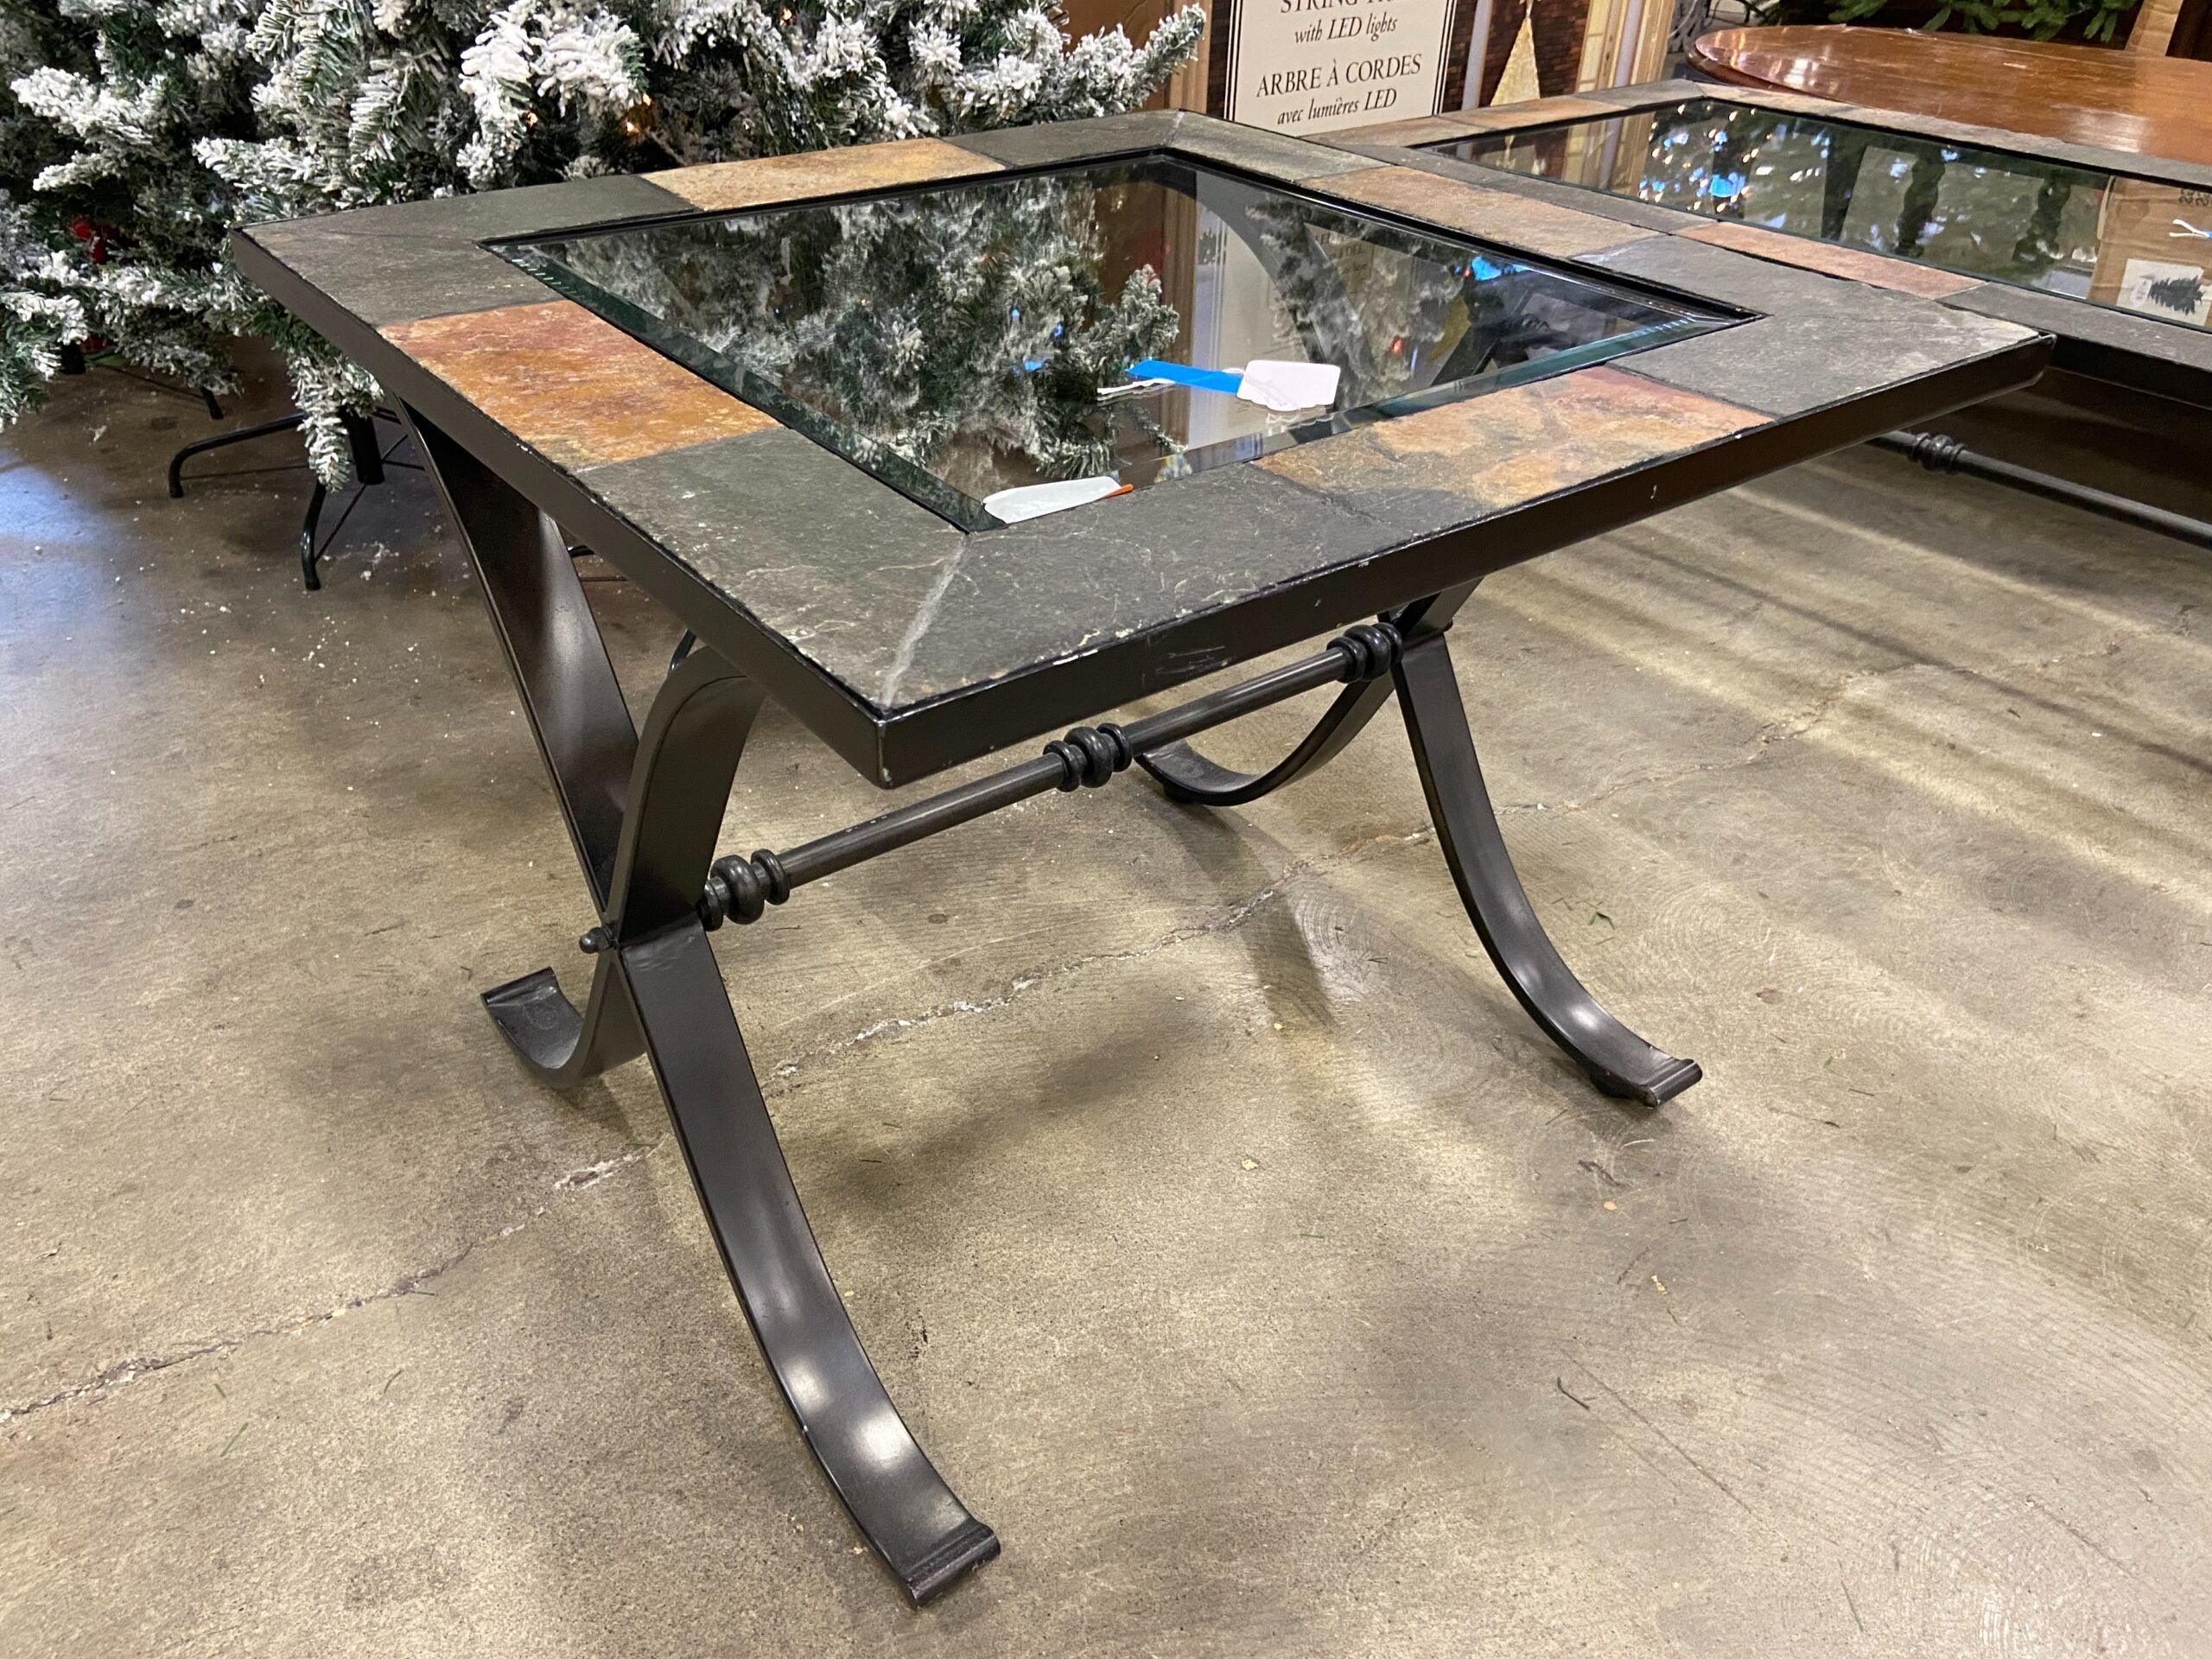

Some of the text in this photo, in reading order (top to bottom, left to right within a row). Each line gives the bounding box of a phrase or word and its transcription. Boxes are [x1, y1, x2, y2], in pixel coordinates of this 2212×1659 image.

[1294, 11, 1398, 43] with LED lights
[1256, 53, 1422, 98] ARBRE À CORDES
[1277, 87, 1397, 125] avec lumières LED
